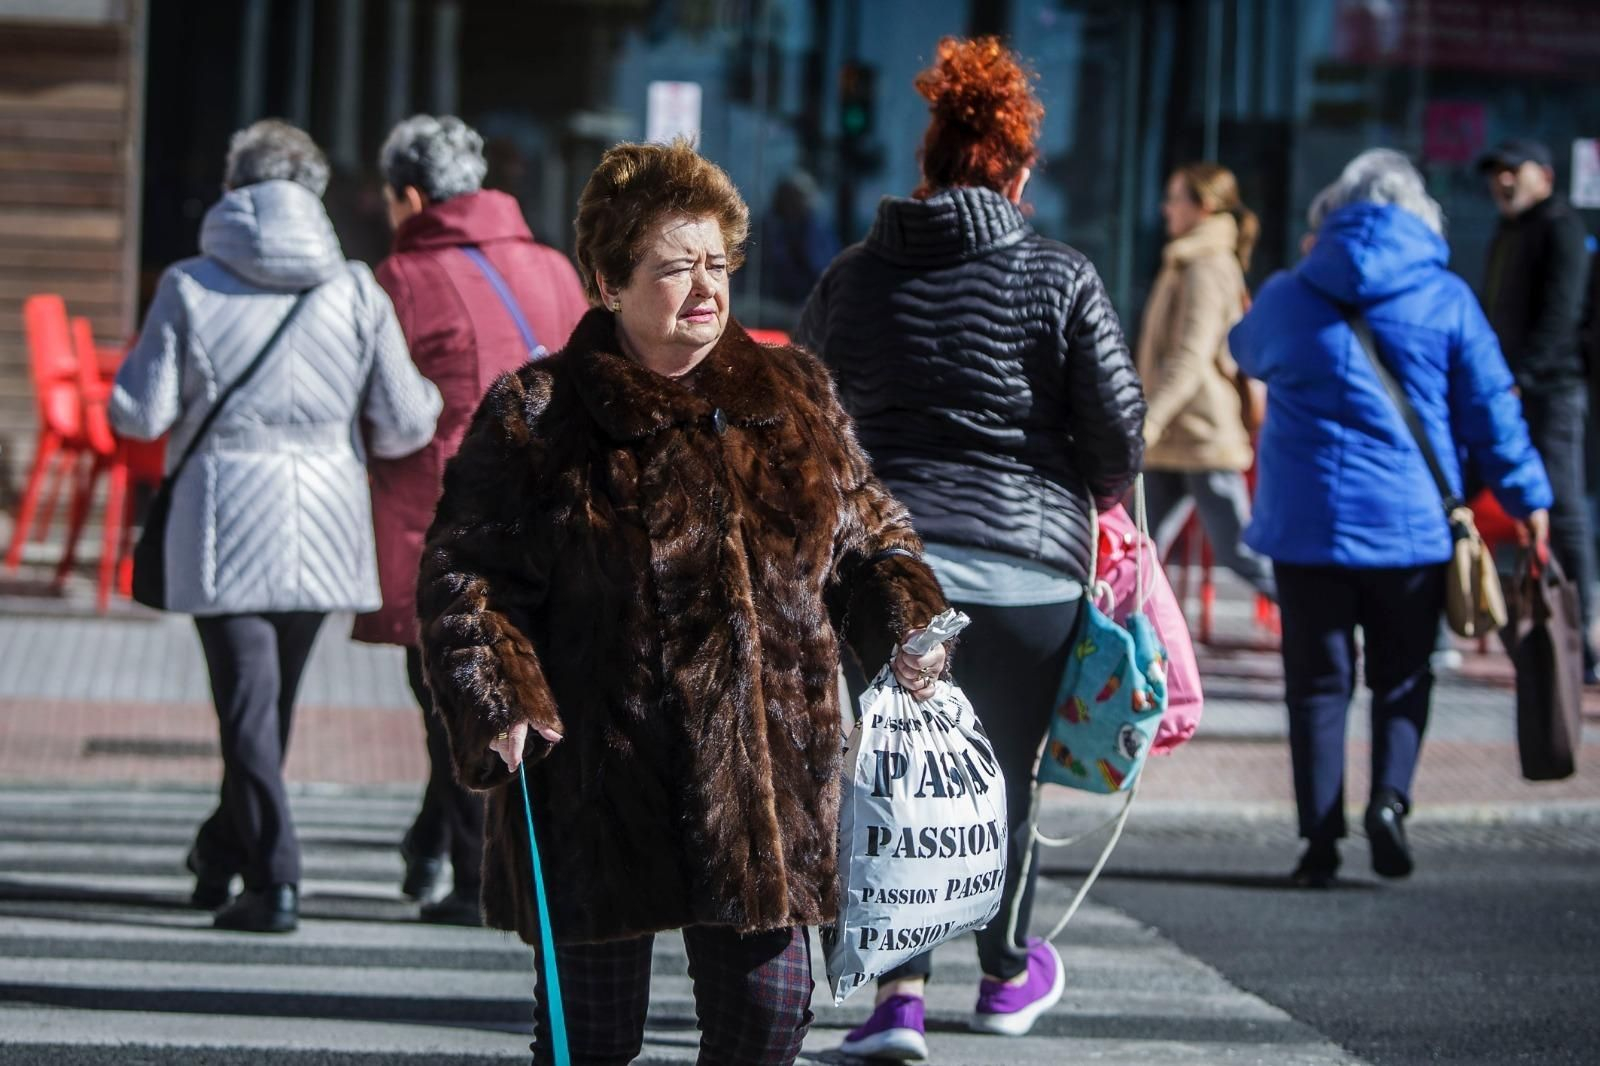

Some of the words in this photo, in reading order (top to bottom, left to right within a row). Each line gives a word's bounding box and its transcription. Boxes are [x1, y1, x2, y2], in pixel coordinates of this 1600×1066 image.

[865, 819, 999, 859] PASSION
[862, 887, 938, 904] PASSION
[858, 920, 956, 950] PASSION
